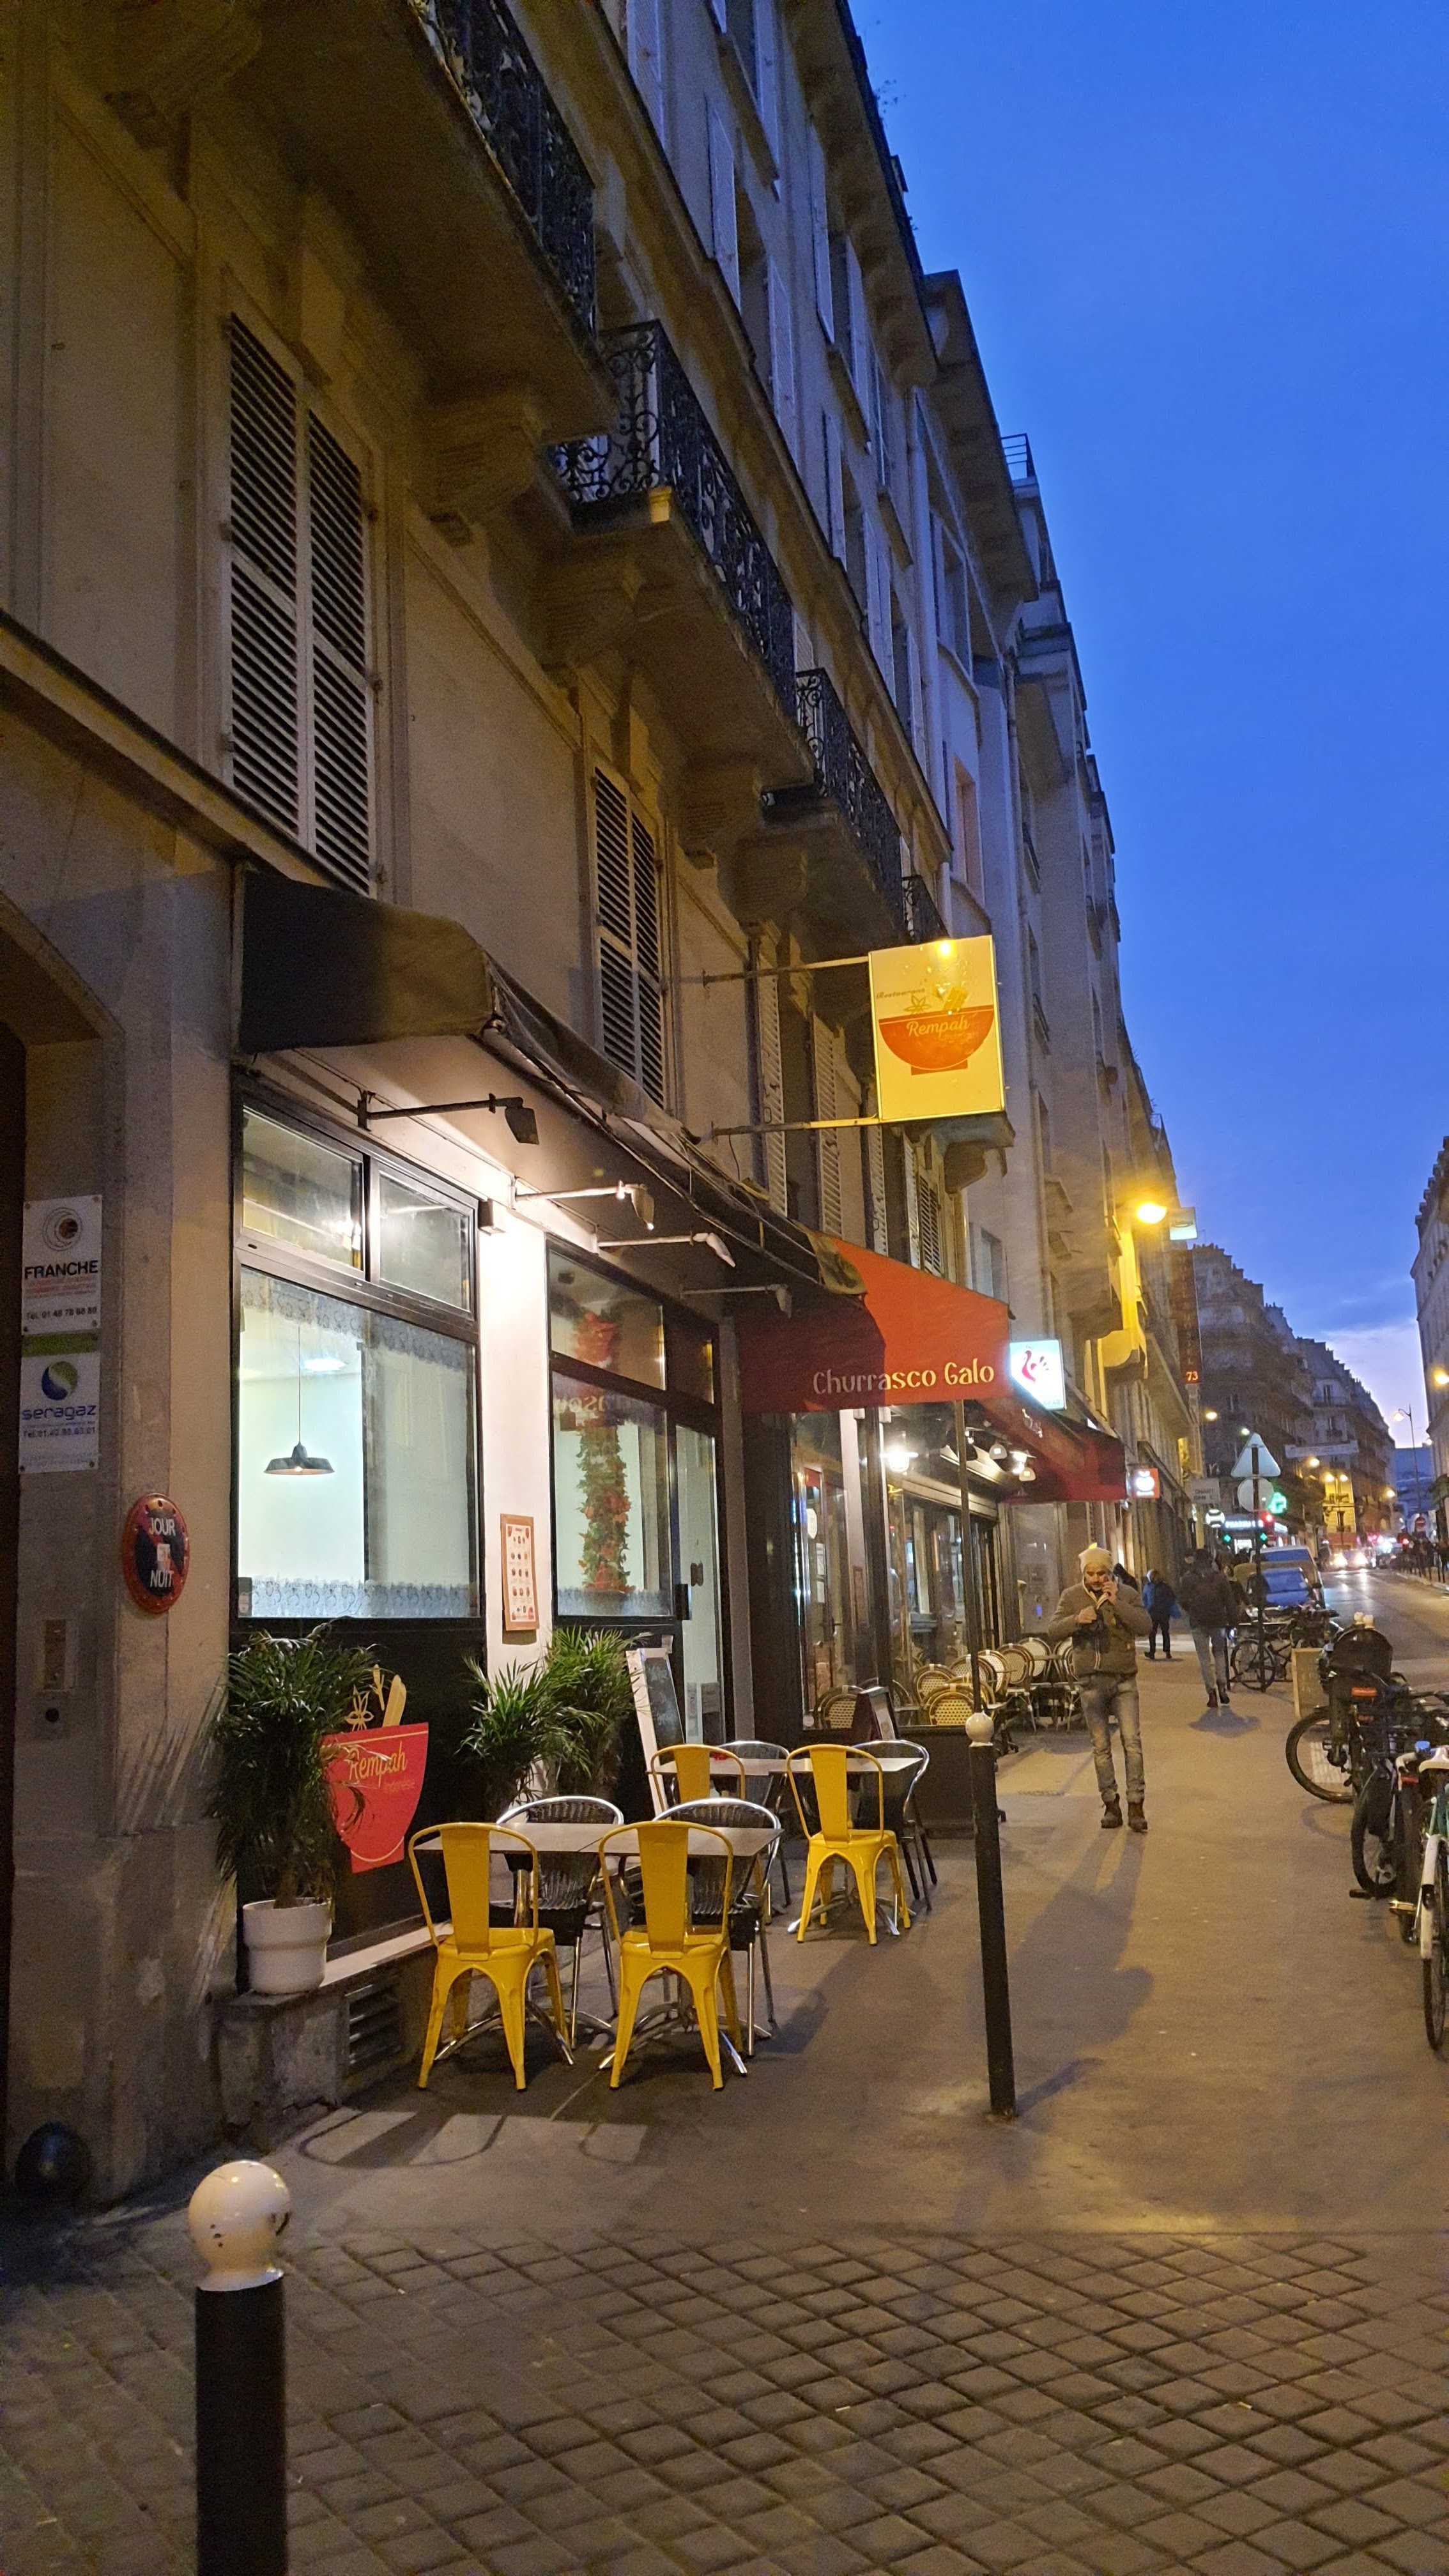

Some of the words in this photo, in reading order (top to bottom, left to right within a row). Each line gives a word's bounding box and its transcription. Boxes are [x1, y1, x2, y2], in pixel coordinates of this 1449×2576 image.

[876, 988, 926, 1000] Restaurant
[906, 1016, 970, 1038] Rempah
[24, 1260, 98, 1279] FRANCHE
[813, 1368, 937, 1395] Churrasco
[944, 1358, 994, 1385] Galo
[1185, 1370, 1199, 1381] 73
[21, 1405, 96, 1420] seragaz
[150, 1517, 176, 1537] JOUR
[150, 1570, 174, 1588] NUIT
